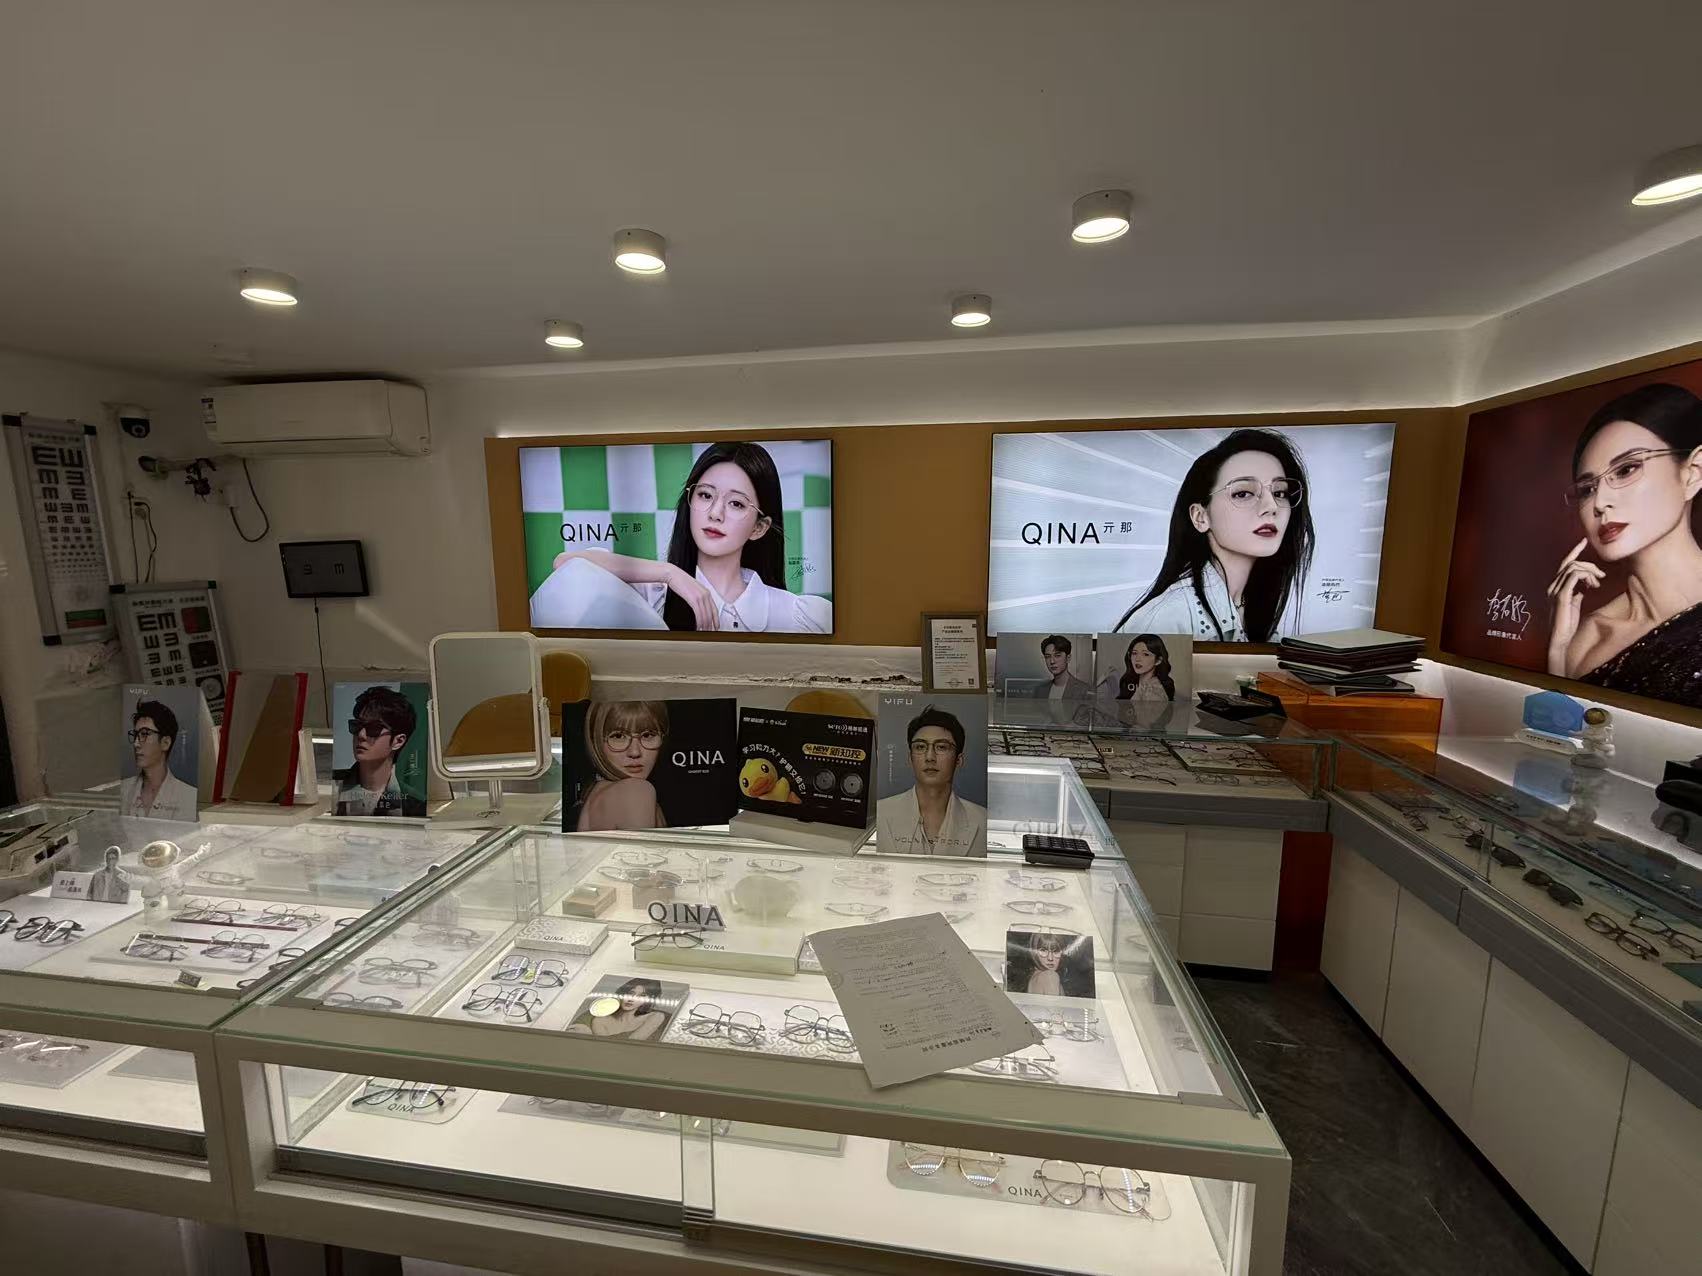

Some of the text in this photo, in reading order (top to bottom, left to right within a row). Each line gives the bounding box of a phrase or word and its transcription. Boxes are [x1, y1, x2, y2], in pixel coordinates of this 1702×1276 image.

[560, 523, 619, 543] QINA
[1022, 521, 1133, 545] QINA 亓那
[672, 750, 725, 768] QINA
[647, 901, 724, 927] QINA
[543, 934, 565, 942] QINA
[387, 1103, 414, 1113] QINA
[1008, 1185, 1043, 1199] QINA
